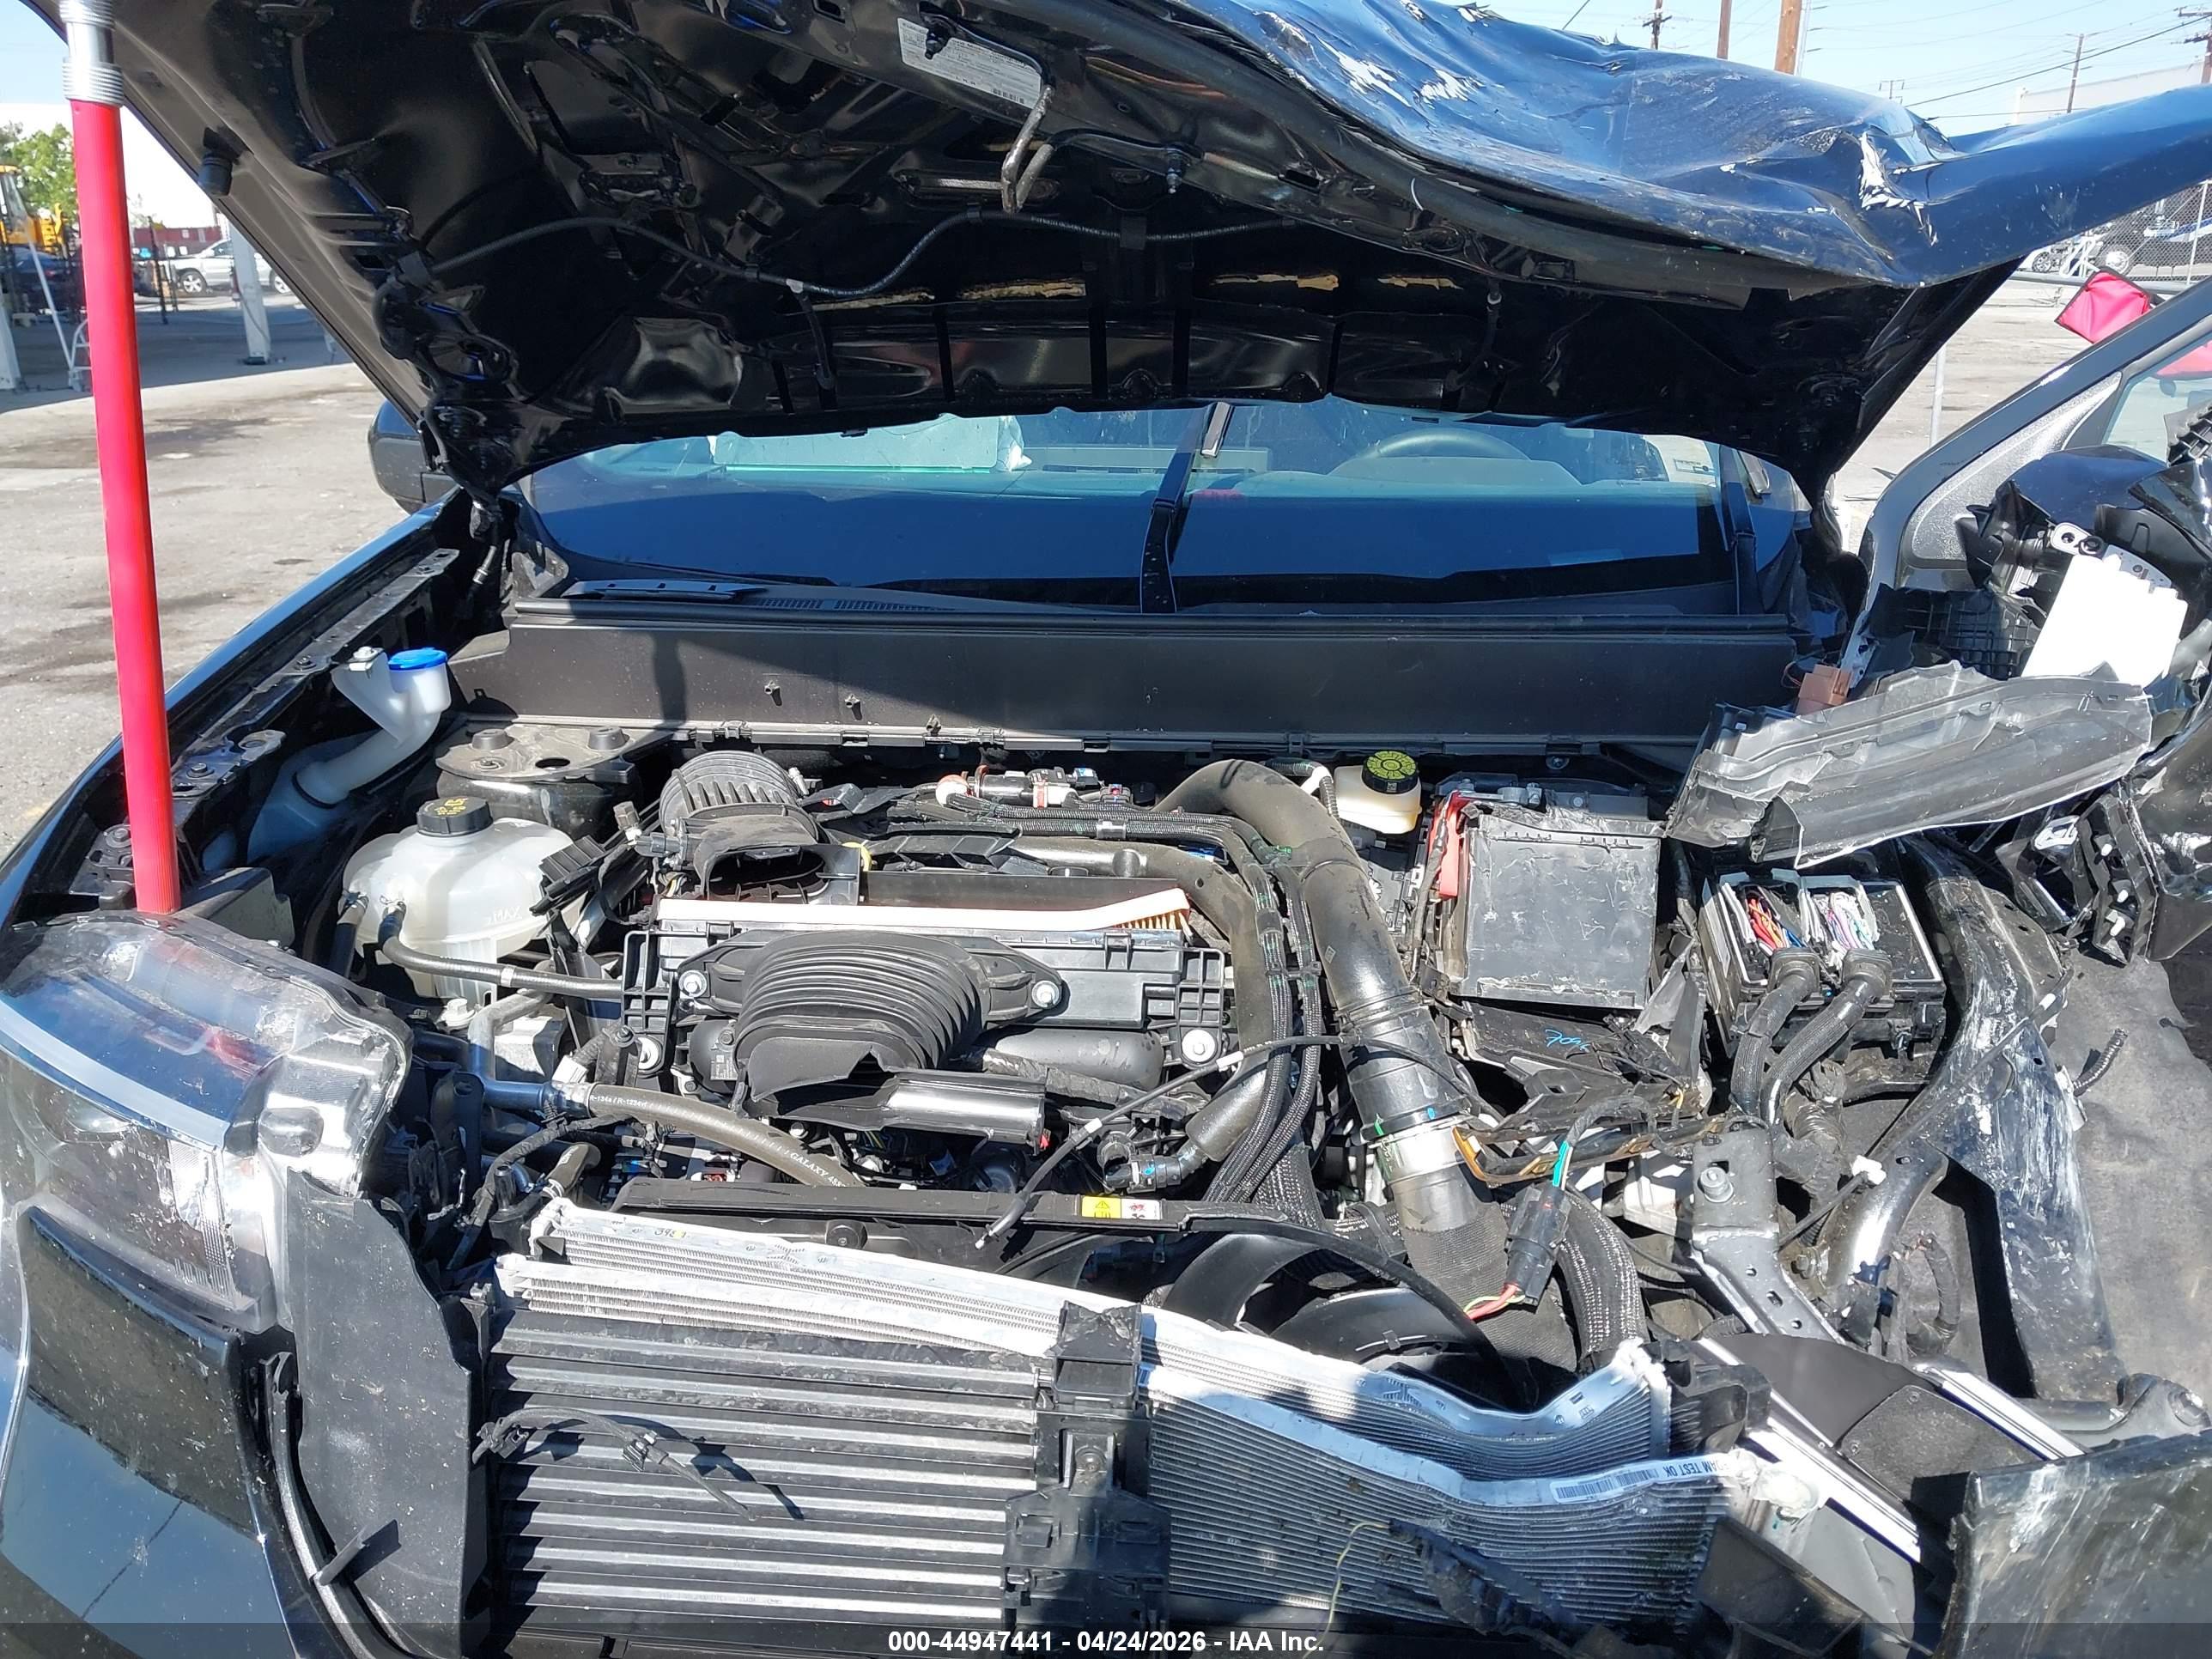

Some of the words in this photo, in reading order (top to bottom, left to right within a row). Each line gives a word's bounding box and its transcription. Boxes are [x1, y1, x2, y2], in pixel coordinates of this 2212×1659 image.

[790, 1152, 829, 1176] GALAXY
[1662, 1466, 1678, 1478] OK
[1679, 1462, 1703, 1476] TEST
